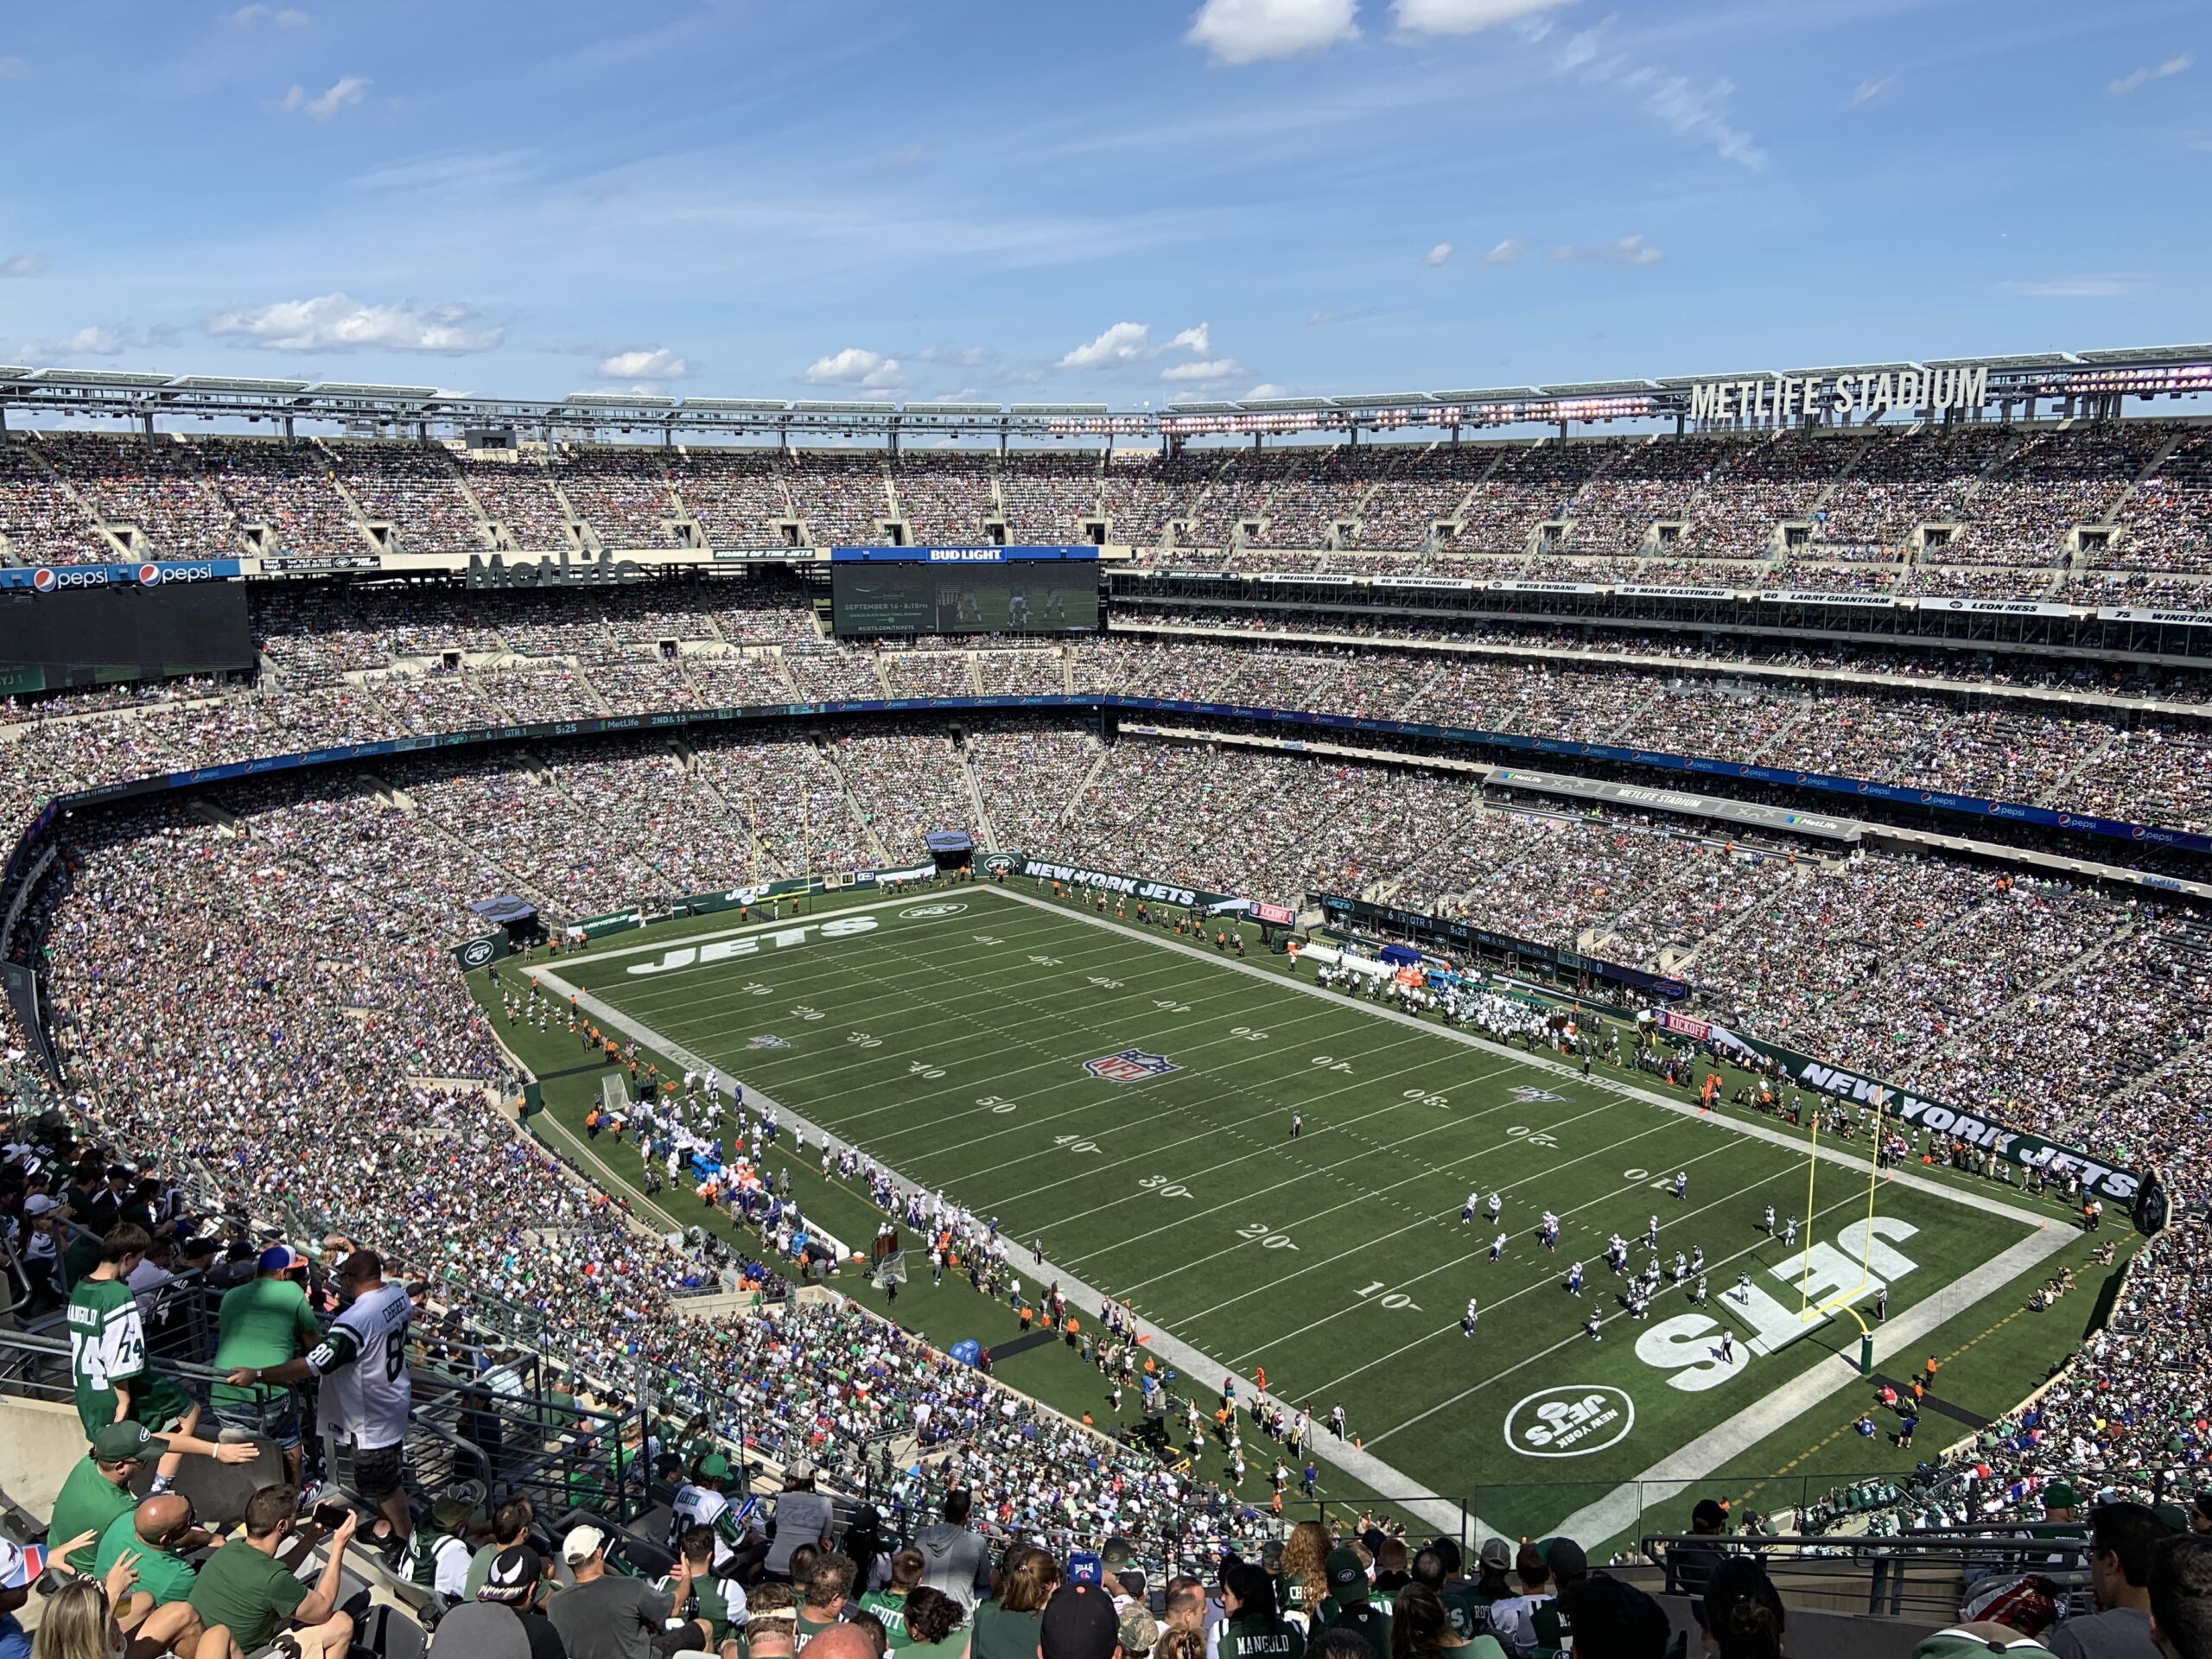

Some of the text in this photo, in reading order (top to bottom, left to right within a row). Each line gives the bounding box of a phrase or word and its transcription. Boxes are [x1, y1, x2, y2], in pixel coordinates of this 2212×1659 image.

[1690, 377, 1823, 420] METLIFE
[1834, 367, 1987, 414] STADIUM
[715, 550, 747, 558] HOME
[930, 550, 1002, 561] BUD LIGHT
[162, 564, 213, 584] pepsi
[466, 548, 640, 588] MetLife
[58, 564, 109, 588] pepsi
[1790, 594, 1825, 602] LARRY
[1827, 596, 1891, 605] GRANTHAM
[2005, 604, 2038, 613] HESS
[555, 724, 577, 734] 5:25
[608, 720, 639, 728] MetLife
[1590, 748, 1608, 757] pepsi
[1642, 754, 1659, 763] pepsi
[1695, 760, 1713, 770] pepsi
[1515, 774, 1541, 784] MetLife
[1750, 767, 1770, 778] pepsi
[1808, 776, 1828, 786] pepsi
[1617, 788, 1702, 808] METLIFE STADIUM
[1869, 786, 1891, 797] pepsi
[1933, 795, 1955, 807] pepsi
[2001, 805, 2025, 817] pepsi
[1802, 817, 1837, 830] MetLife
[2069, 817, 2096, 830] pepsi
[2145, 830, 2173, 842] pepsi
[1025, 861, 1197, 906] NEW YORK JETS
[725, 883, 771, 901] JETS
[1388, 910, 1394, 919] 6
[1409, 915, 1433, 929] QTR 1
[1450, 925, 1467, 938] 5:25
[627, 916, 878, 975] JETS
[1477, 932, 1490, 942] 2ND
[1498, 938, 1506, 946] 13
[1516, 943, 1548, 957] BALL ON 2
[1596, 963, 1604, 975] 0
[741, 983, 773, 995] 10
[790, 1007, 826, 1020] 20
[1669, 1014, 1706, 1038] KICKOFF
[847, 1033, 882, 1047] 30
[909, 1063, 945, 1079] 40
[1095, 1057, 1140, 1080] NFL
[976, 1096, 1016, 1113] 50
[1799, 1063, 1902, 1104] NEW
[1902, 1095, 2018, 1148] YORK
[1054, 1135, 1096, 1153] 40
[1139, 1174, 1184, 1198] 30
[1236, 1223, 1289, 1249] 20
[1353, 1281, 1410, 1310] 10
[1634, 1215, 1920, 1391] JETS
[119, 1338, 143, 1363] 74
[308, 1346, 326, 1366] 80
[70, 1329, 110, 1390] 74
[1525, 1394, 1606, 1446] JETS
[1555, 1408, 1619, 1449] NEW YORK
[1074, 1562, 1094, 1574] BILLS
[869, 1604, 904, 1630] SCOTT
